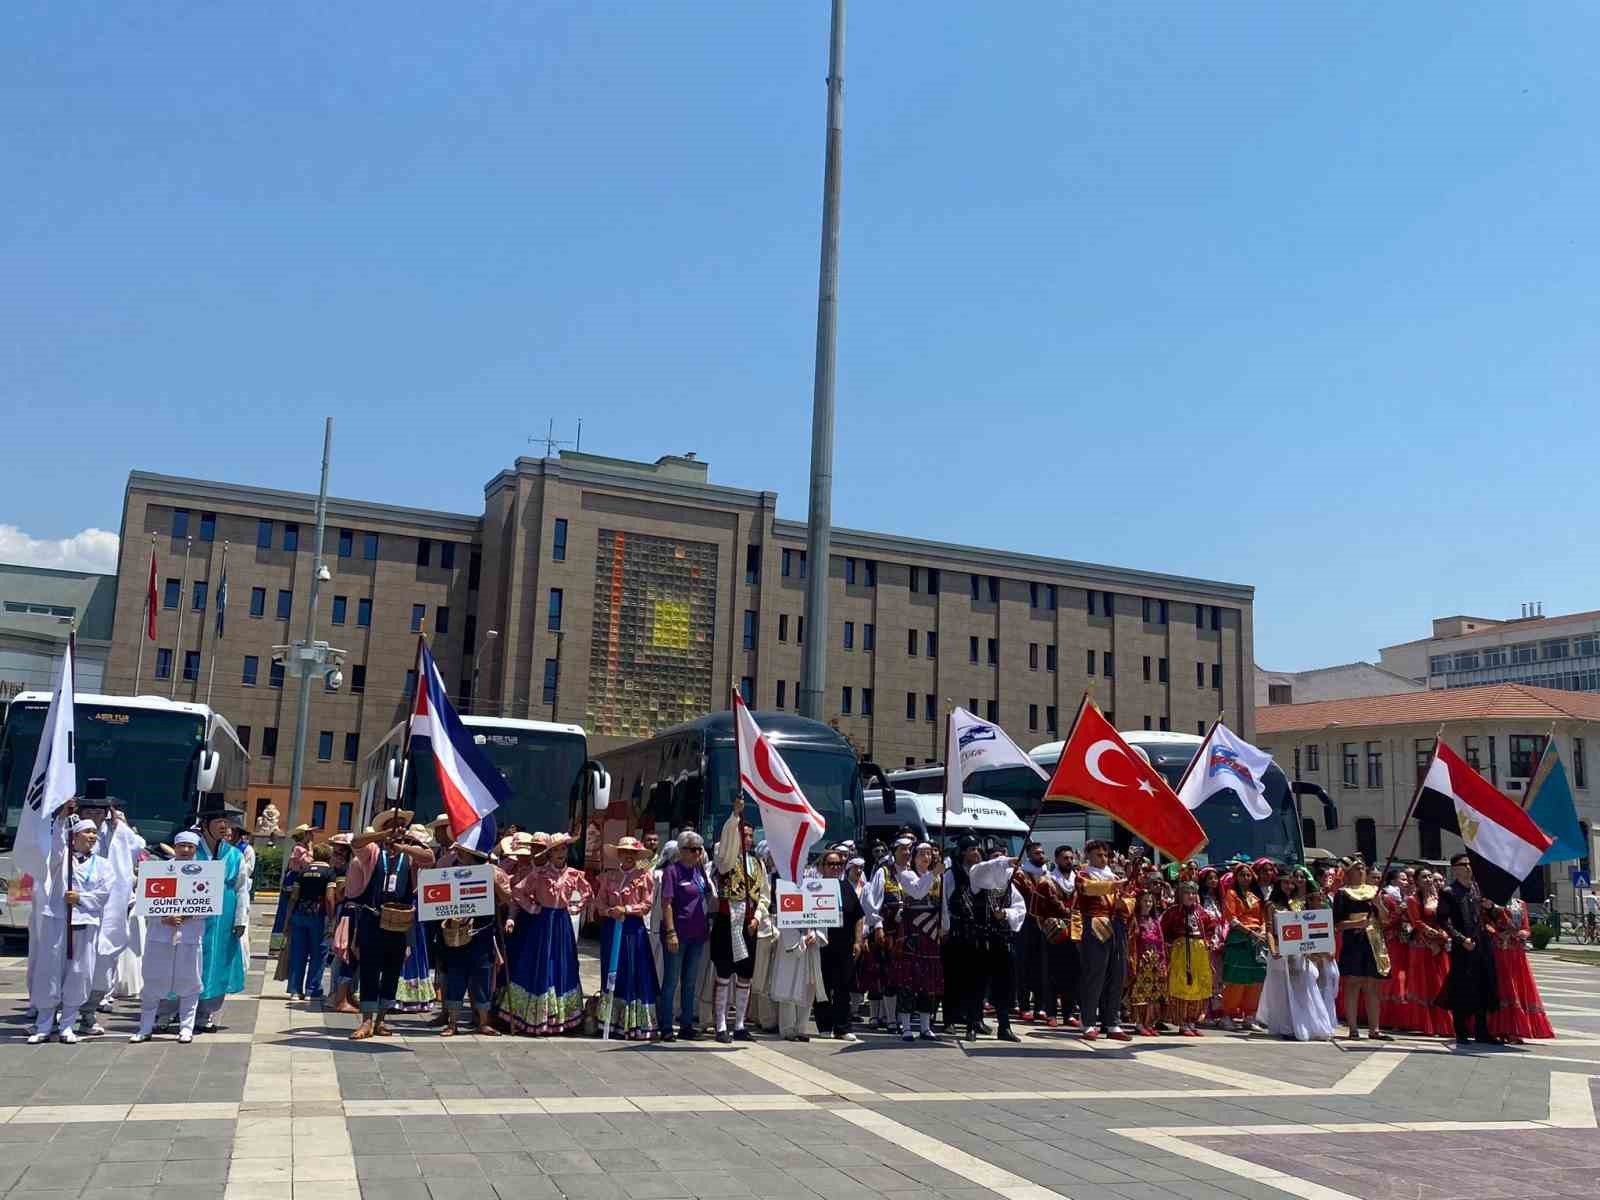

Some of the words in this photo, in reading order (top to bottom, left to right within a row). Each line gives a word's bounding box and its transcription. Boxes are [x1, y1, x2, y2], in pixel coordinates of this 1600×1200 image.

[186, 897, 212, 905] KORE
[148, 906, 181, 914] SOUTH
[435, 904, 458, 912] KOSTA
